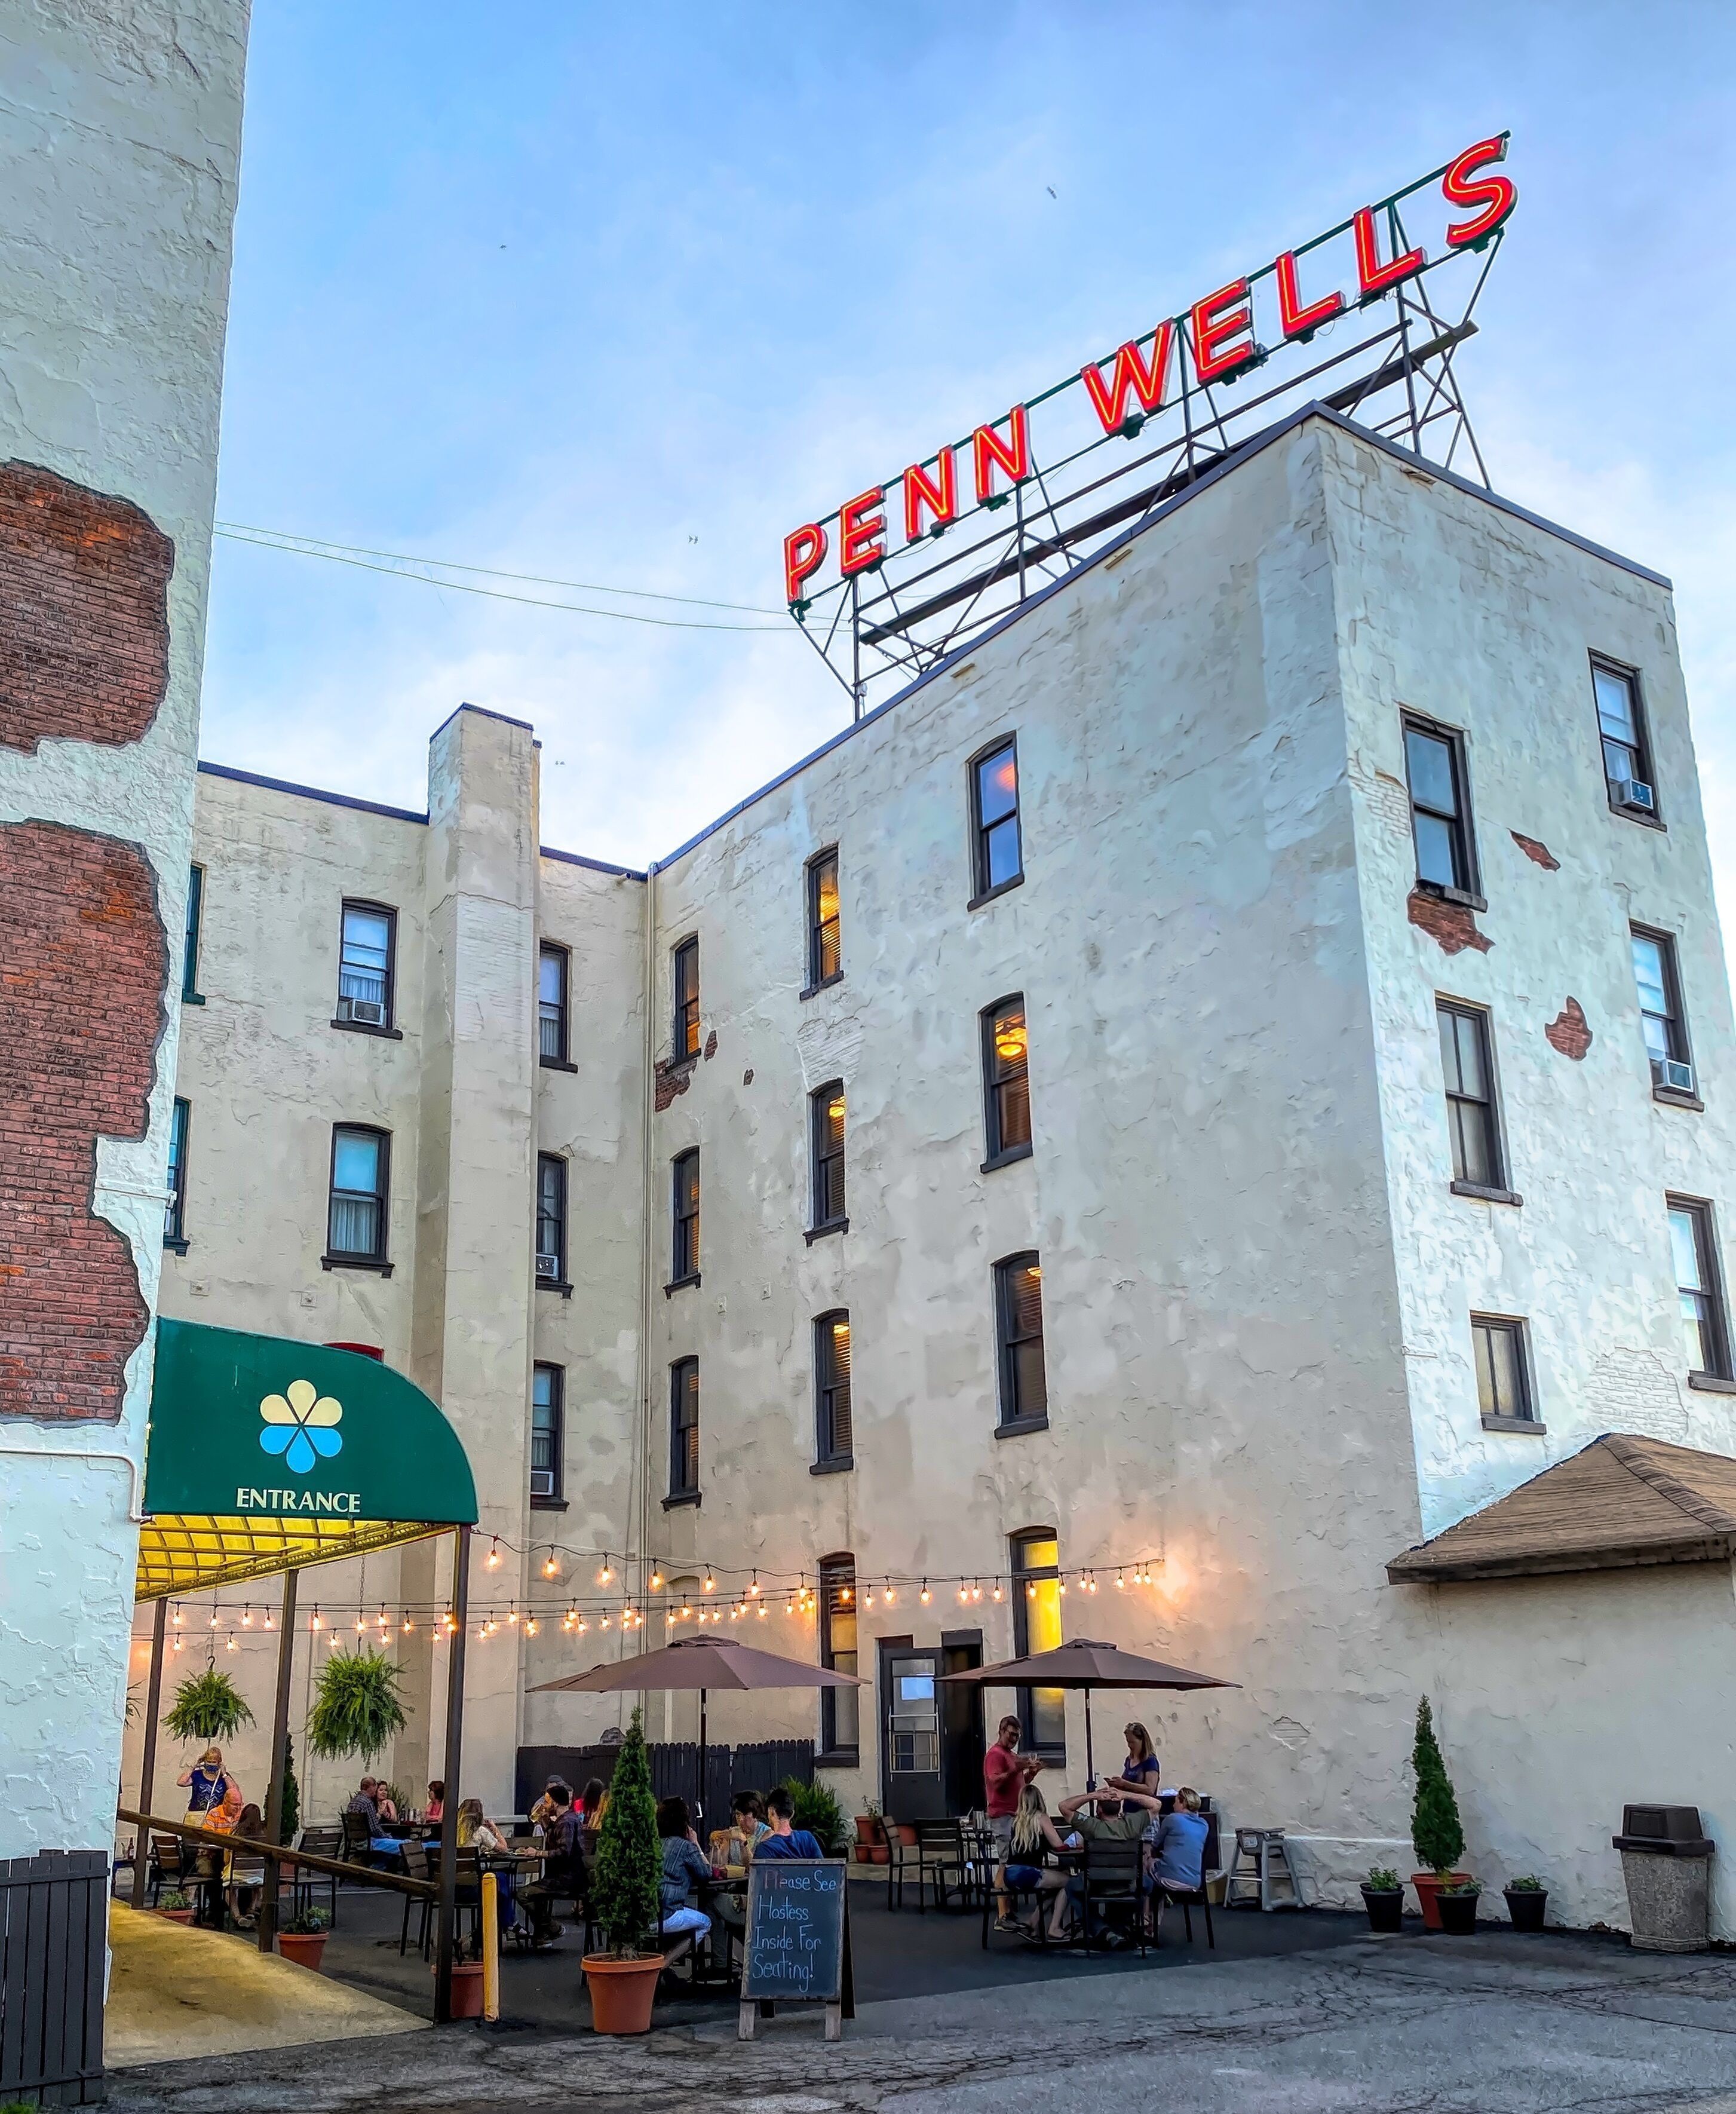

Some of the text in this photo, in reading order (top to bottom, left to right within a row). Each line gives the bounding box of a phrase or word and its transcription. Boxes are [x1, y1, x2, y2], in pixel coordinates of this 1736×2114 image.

[784, 136, 1517, 603] PENN WELLS
[237, 1488, 361, 1513] ENTRANCE
[813, 1869, 836, 1892] See
[757, 1895, 809, 1920] Hostess
[752, 1924, 821, 1950] Inside For
[753, 1951, 814, 1993] Seating!
